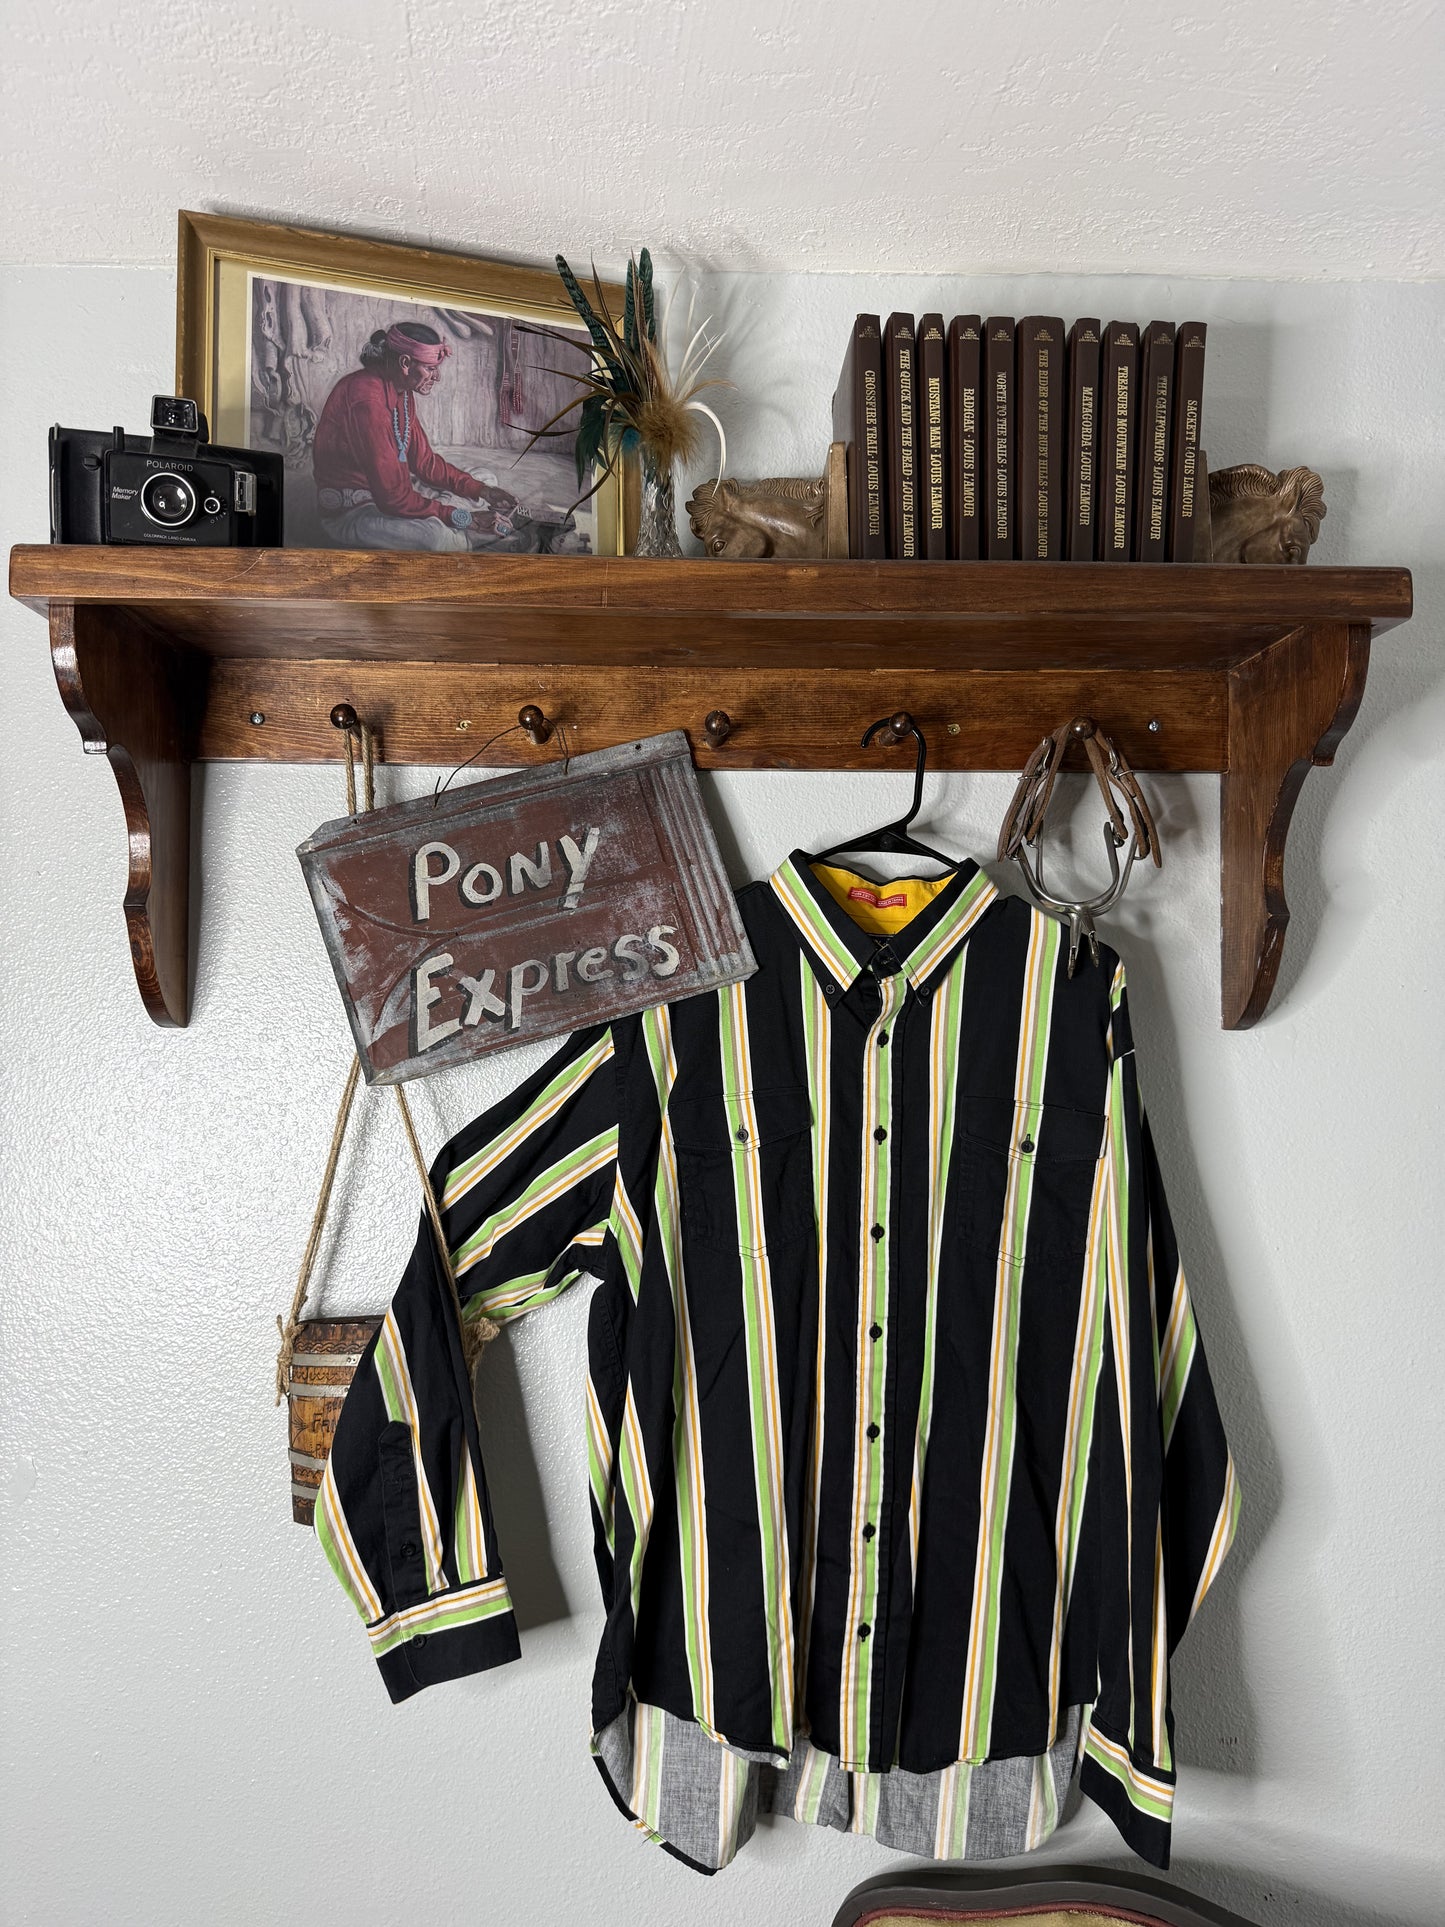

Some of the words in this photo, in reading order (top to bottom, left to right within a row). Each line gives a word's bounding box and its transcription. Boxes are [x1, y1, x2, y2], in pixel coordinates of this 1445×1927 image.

[900, 349, 911, 369] THE
[1038, 349, 1049, 368] THE
[864, 370, 877, 424] CROSSFIRE
[900, 371, 912, 398] QUICK
[996, 372, 1007, 402] NORTH
[1038, 370, 1049, 398] RIDER
[1117, 366, 1129, 416] TREASURE
[1156, 376, 1168, 396] THE
[901, 399, 912, 424] AND
[928, 378, 941, 424] MUSTANG
[963, 388, 975, 434] RADIGAN
[996, 404, 1007, 416] TO
[1038, 400, 1049, 412] OF
[996, 418, 1007, 436] THE
[1038, 413, 1049, 432] THE
[1081, 386, 1094, 447] MATAGORDA
[1154, 398, 1168, 462] CALIFORNIOS
[1185, 400, 1198, 442] SACKETT
[866, 427, 878, 456] TRAIL
[901, 427, 912, 447] THE
[929, 426, 942, 448] MAN
[997, 438, 1007, 464] RAILS
[1038, 434, 1048, 457] RUBY
[1115, 418, 1128, 470] MOUNTAIN
[146, 460, 194, 472] POLAROID
[902, 448, 913, 476] DEAD
[930, 454, 942, 484] LOUIS
[963, 439, 975, 470] LOUIS
[1080, 452, 1092, 481] LOUIS
[867, 460, 879, 490] LOUIS
[997, 468, 1008, 497] LOUIS
[1038, 459, 1048, 486] HILLS
[1152, 466, 1164, 496] LOUIS
[112, 486, 138, 496] Memory
[902, 481, 914, 512] LOUIS
[963, 472, 975, 517] L'AMOUR
[1038, 490, 1048, 518] LOUIS
[1114, 474, 1127, 505] LOUIS
[997, 499, 1008, 539] L'AMOUR
